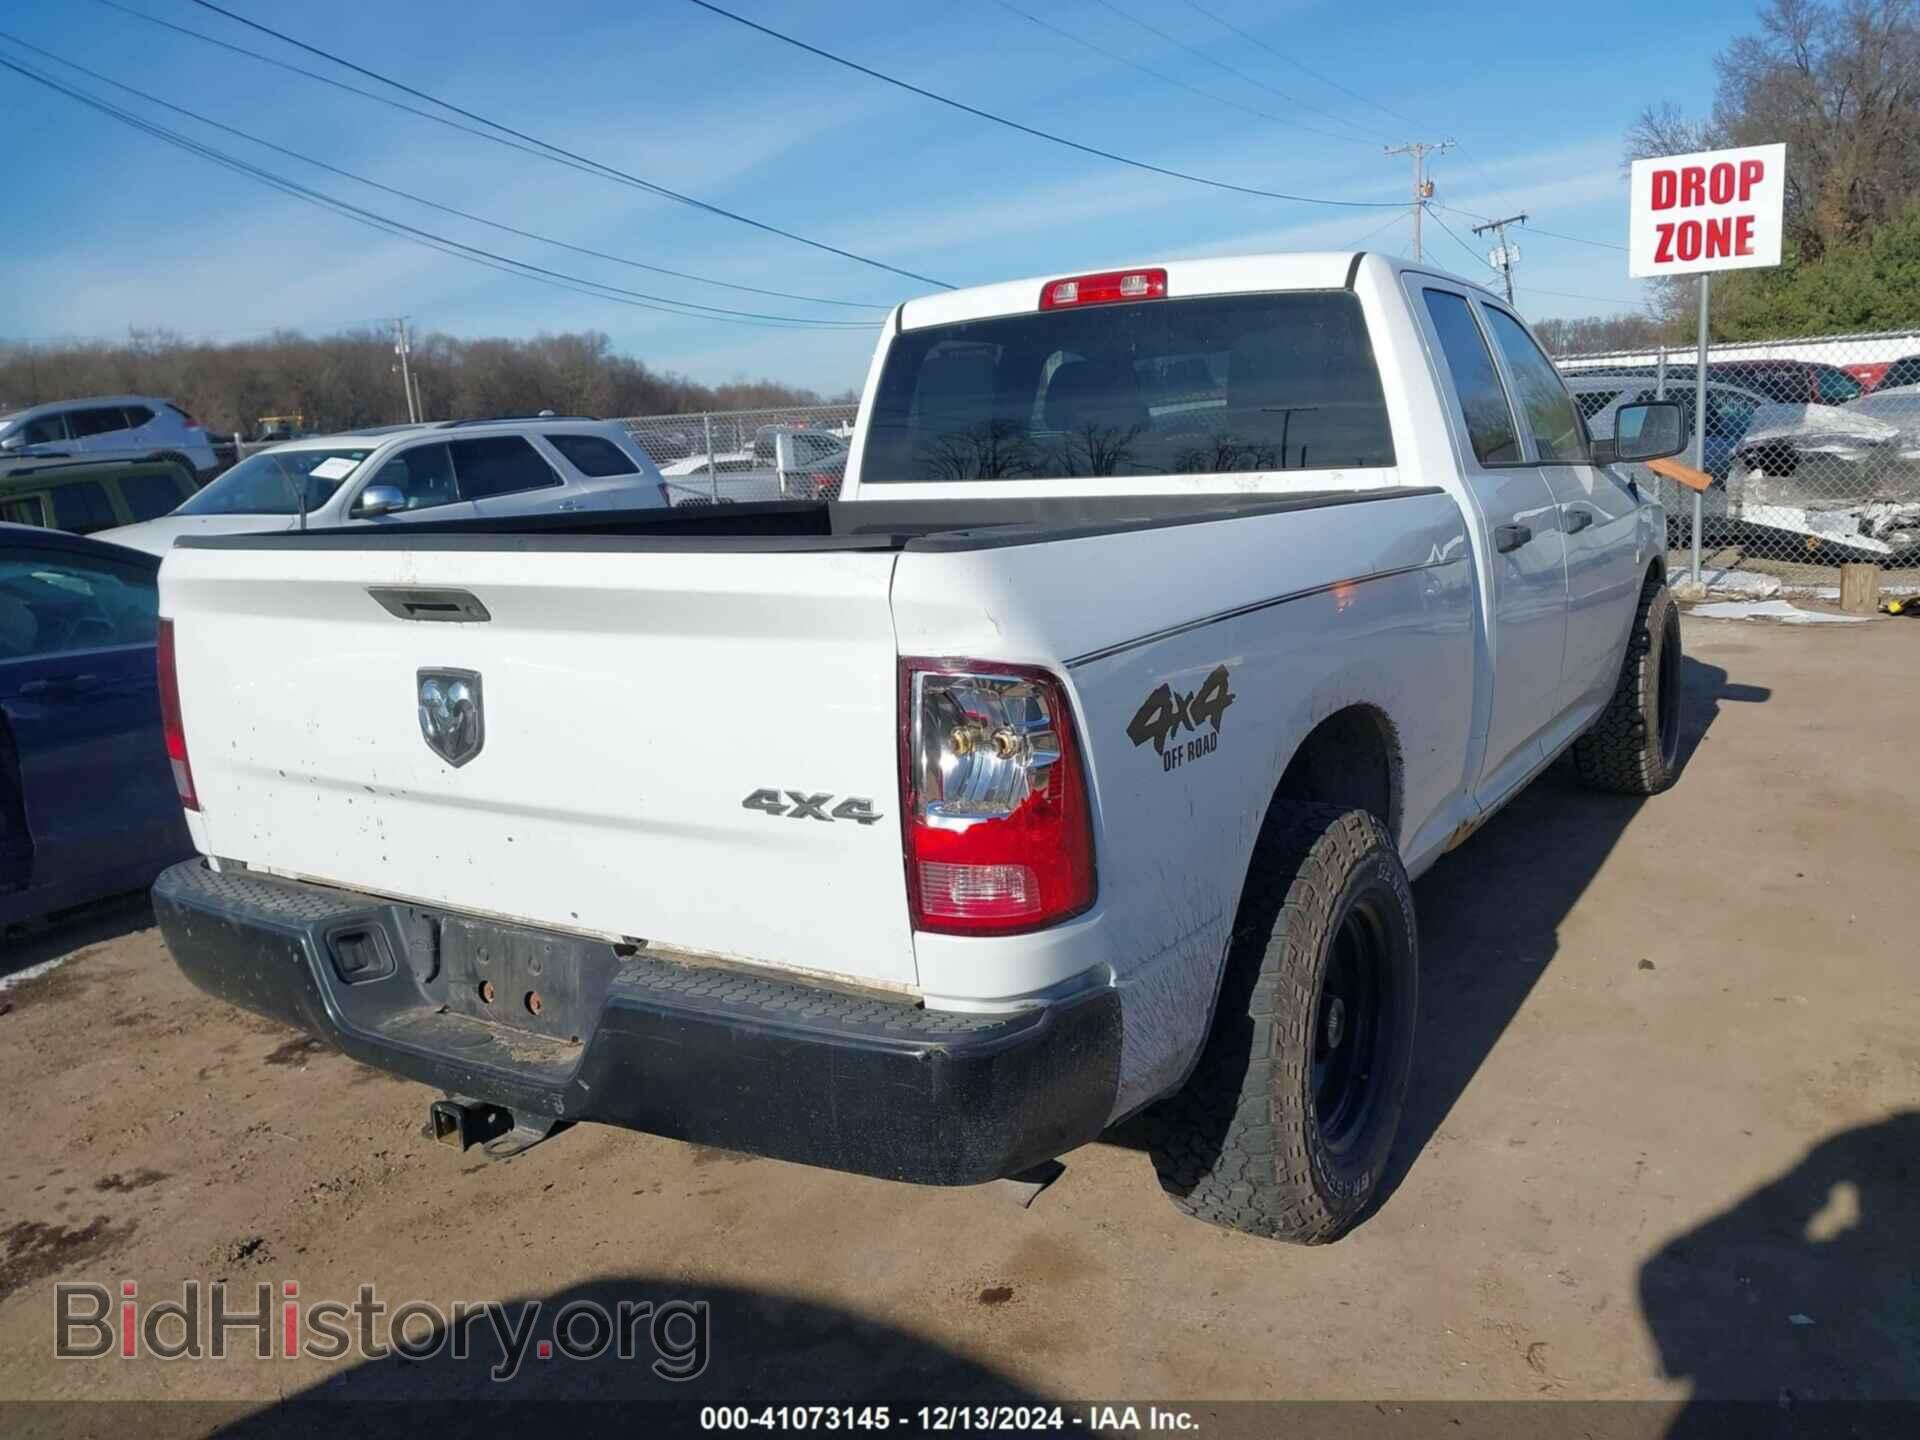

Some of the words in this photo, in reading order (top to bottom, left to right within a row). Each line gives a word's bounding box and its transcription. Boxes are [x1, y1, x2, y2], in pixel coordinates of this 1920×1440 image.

[1651, 159, 1765, 210] DROP
[1654, 215, 1756, 263] ZONE
[1163, 745, 1184, 772] OFF
[1187, 732, 1217, 762] ROAD
